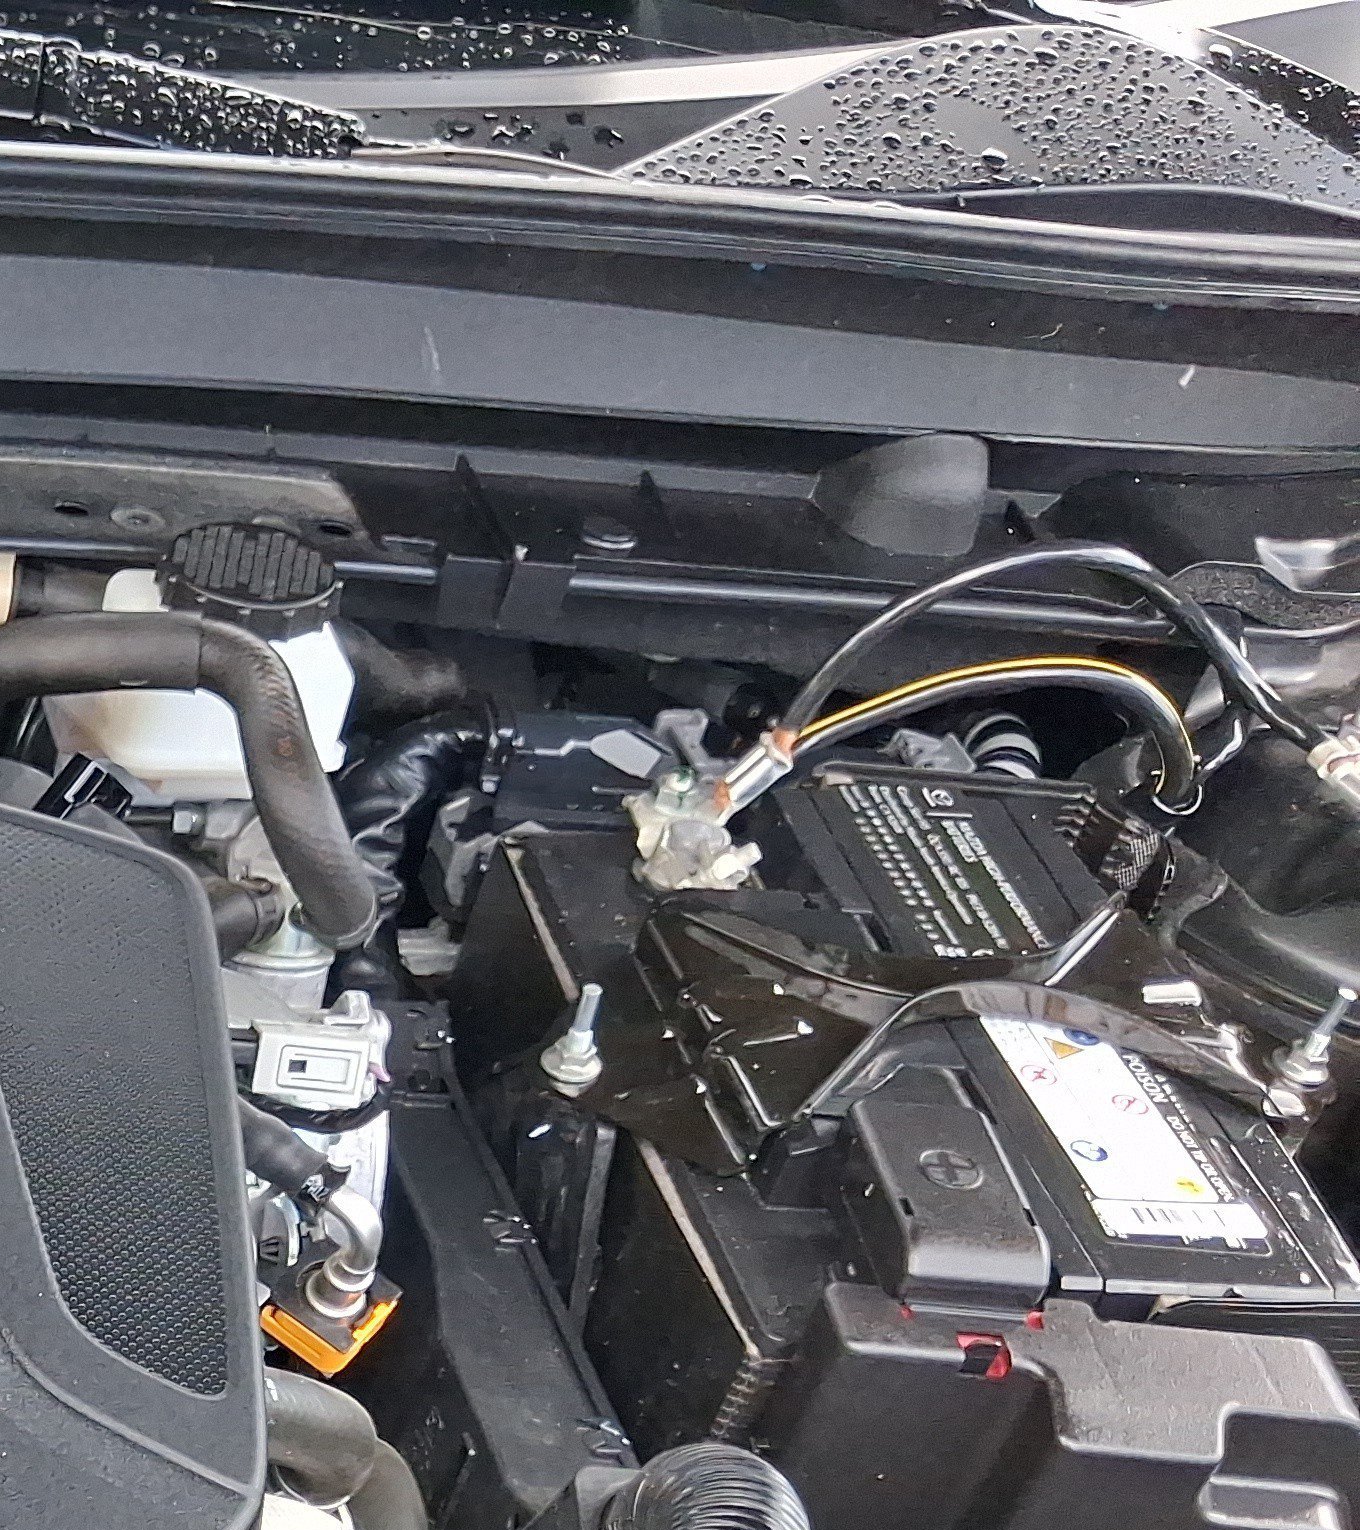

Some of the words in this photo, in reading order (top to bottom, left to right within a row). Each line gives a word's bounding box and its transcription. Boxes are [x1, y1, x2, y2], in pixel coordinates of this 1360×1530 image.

[1122, 1054, 1169, 1103] POISON
[1164, 1115, 1186, 1132] DO
[1177, 1131, 1199, 1149] NOT
